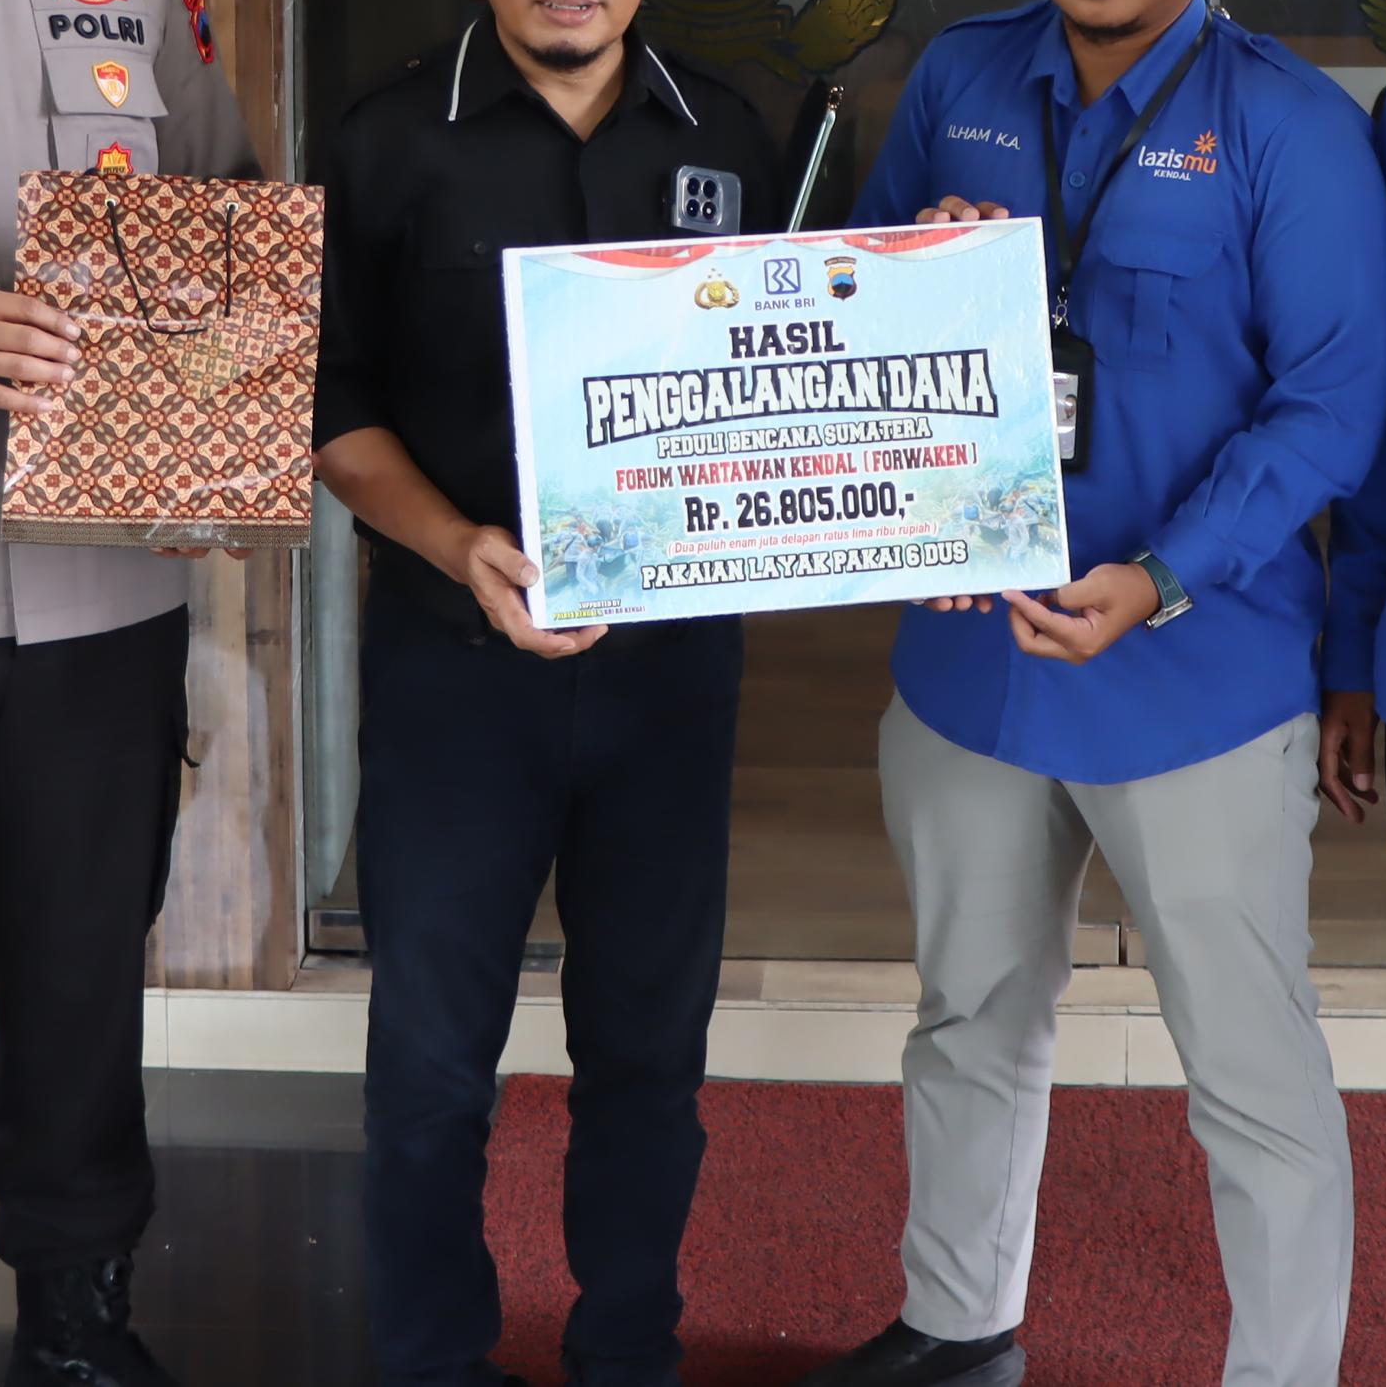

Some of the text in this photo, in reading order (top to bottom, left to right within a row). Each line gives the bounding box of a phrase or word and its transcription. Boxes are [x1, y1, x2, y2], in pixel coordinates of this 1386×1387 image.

[48, 13, 145, 46] POLRI
[947, 124, 990, 143] ILHAM
[1138, 145, 1218, 174] lazismu
[1153, 169, 1192, 182] KENDAL
[754, 297, 815, 312] BANK BRI
[729, 320, 845, 360] HASIL
[584, 348, 999, 447] PENGGALANGAN DANA
[656, 417, 933, 459] PEDULI BENCANA SUMATERA
[616, 466, 674, 492] FORUM
[678, 457, 787, 486] WARTAWAN
[790, 453, 857, 478] KENDAL
[735, 481, 915, 529] 26.805.000,-
[697, 539, 726, 554] puluh
[729, 537, 756, 549] enam
[759, 533, 779, 550] juta
[781, 531, 821, 546] delapan
[823, 529, 849, 542] ratus
[852, 526, 874, 539] lima
[876, 525, 896, 537] ribu
[641, 539, 969, 590] PAKAIAN LAYAK PAKAI 6 DUS
